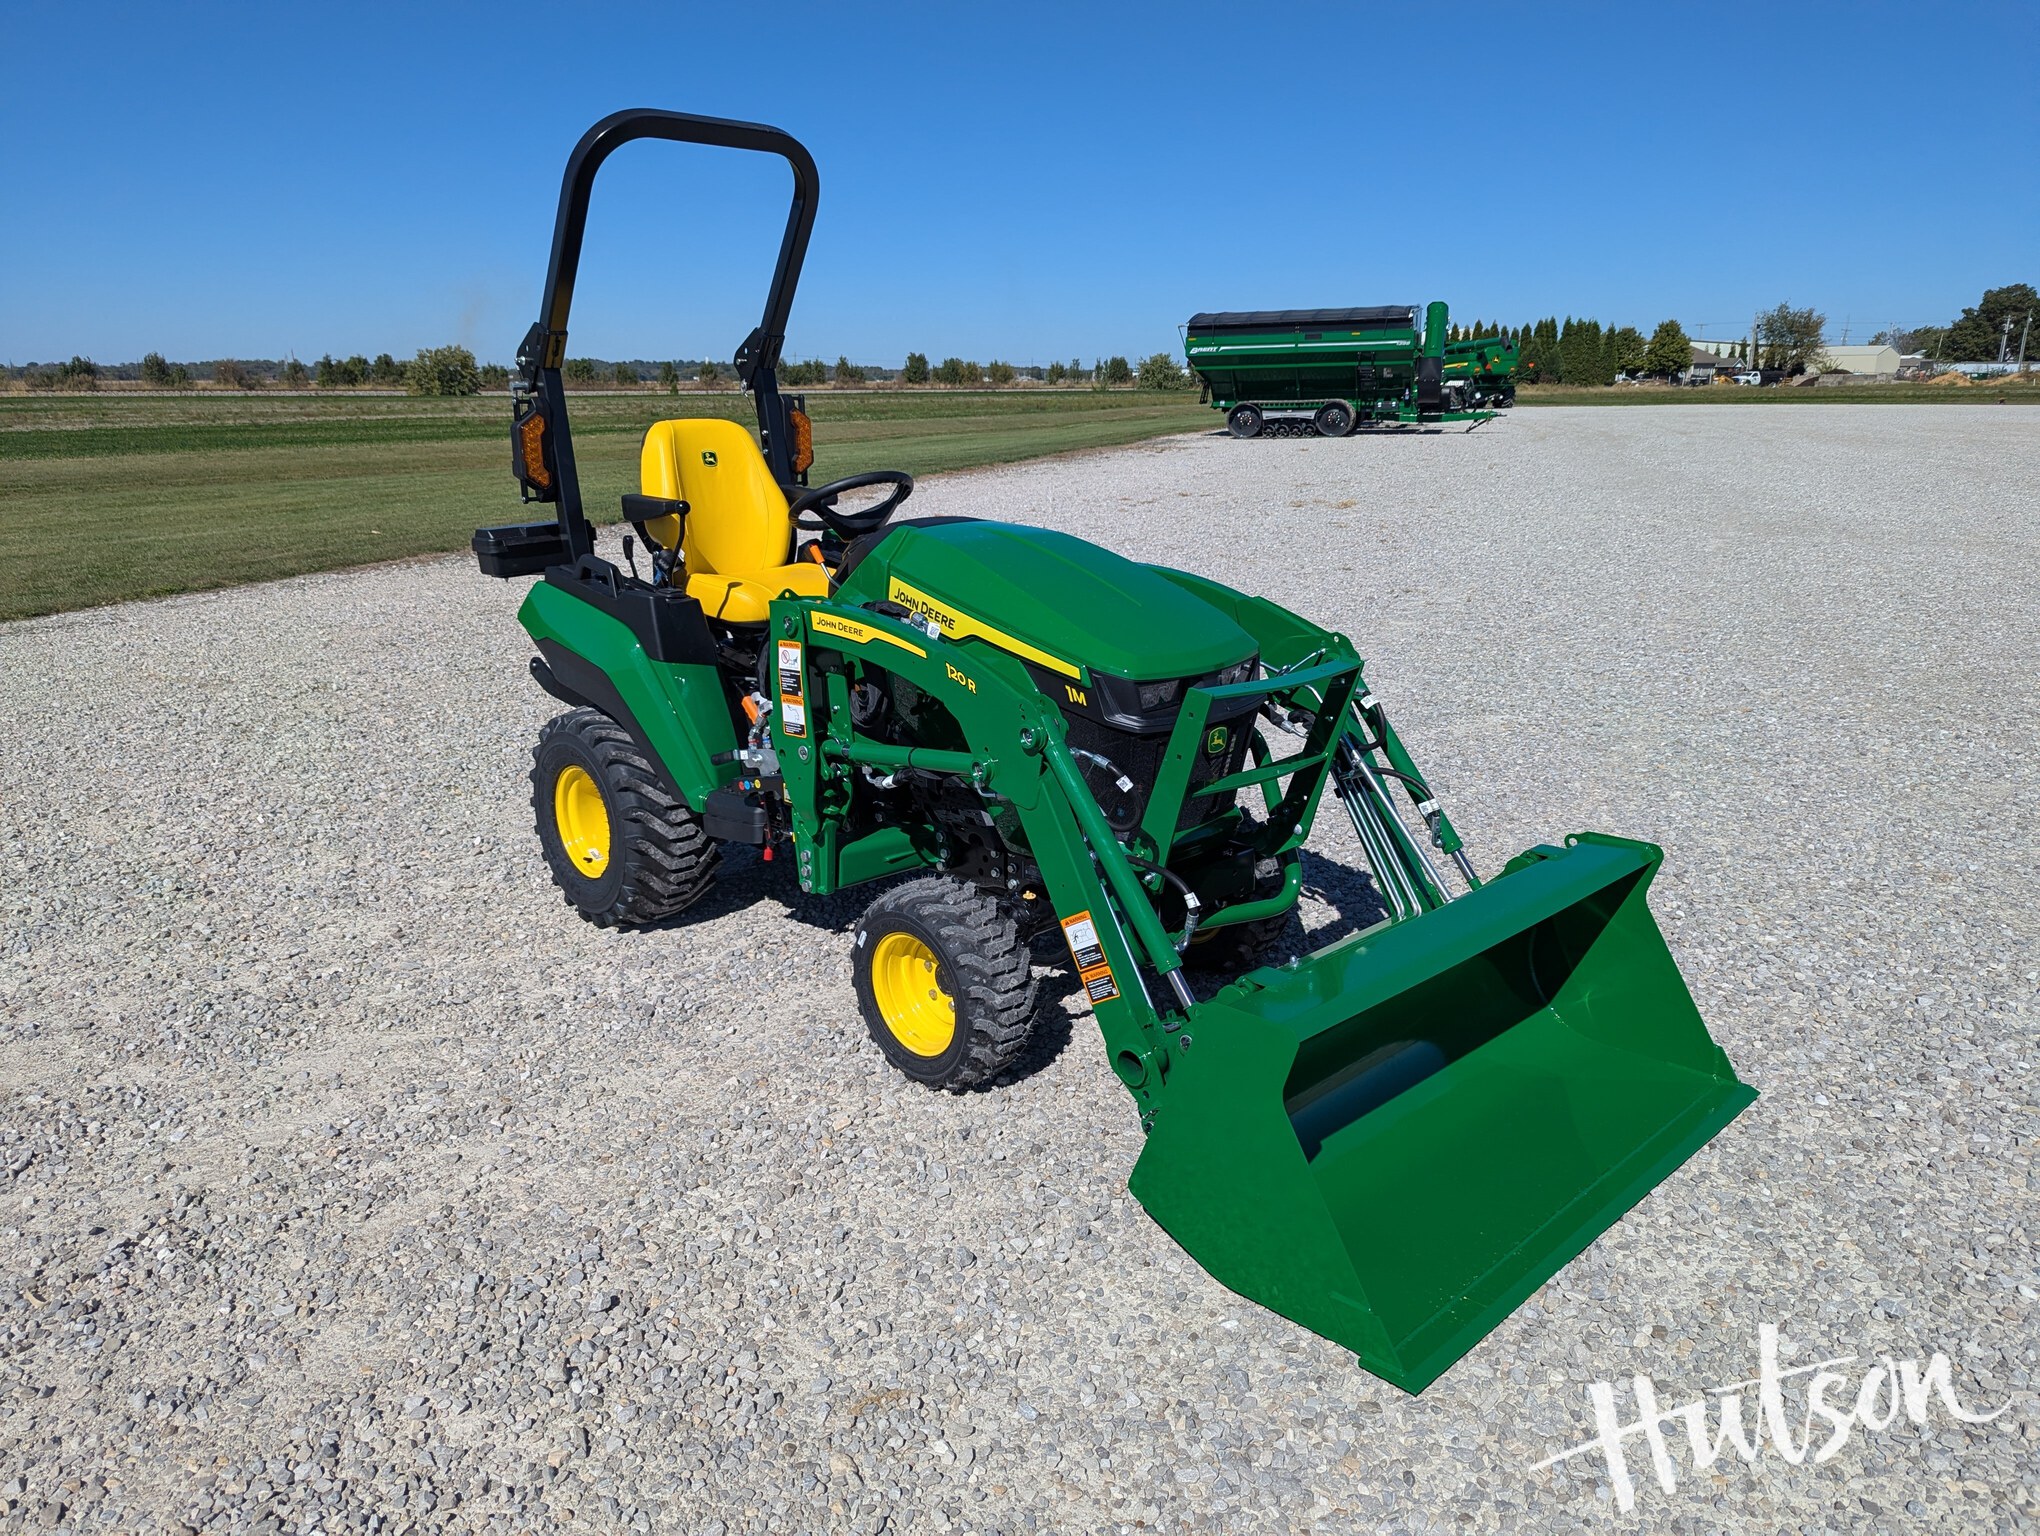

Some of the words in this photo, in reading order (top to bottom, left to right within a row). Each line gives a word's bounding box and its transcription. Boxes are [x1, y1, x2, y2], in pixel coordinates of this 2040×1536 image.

[894, 588, 919, 611] JOHN
[920, 602, 955, 630] DEERE
[817, 617, 836, 629] JOHN
[838, 622, 863, 637] DEERE
[945, 662, 966, 686] 120
[967, 678, 977, 695] R
[1064, 684, 1087, 706] 1M
